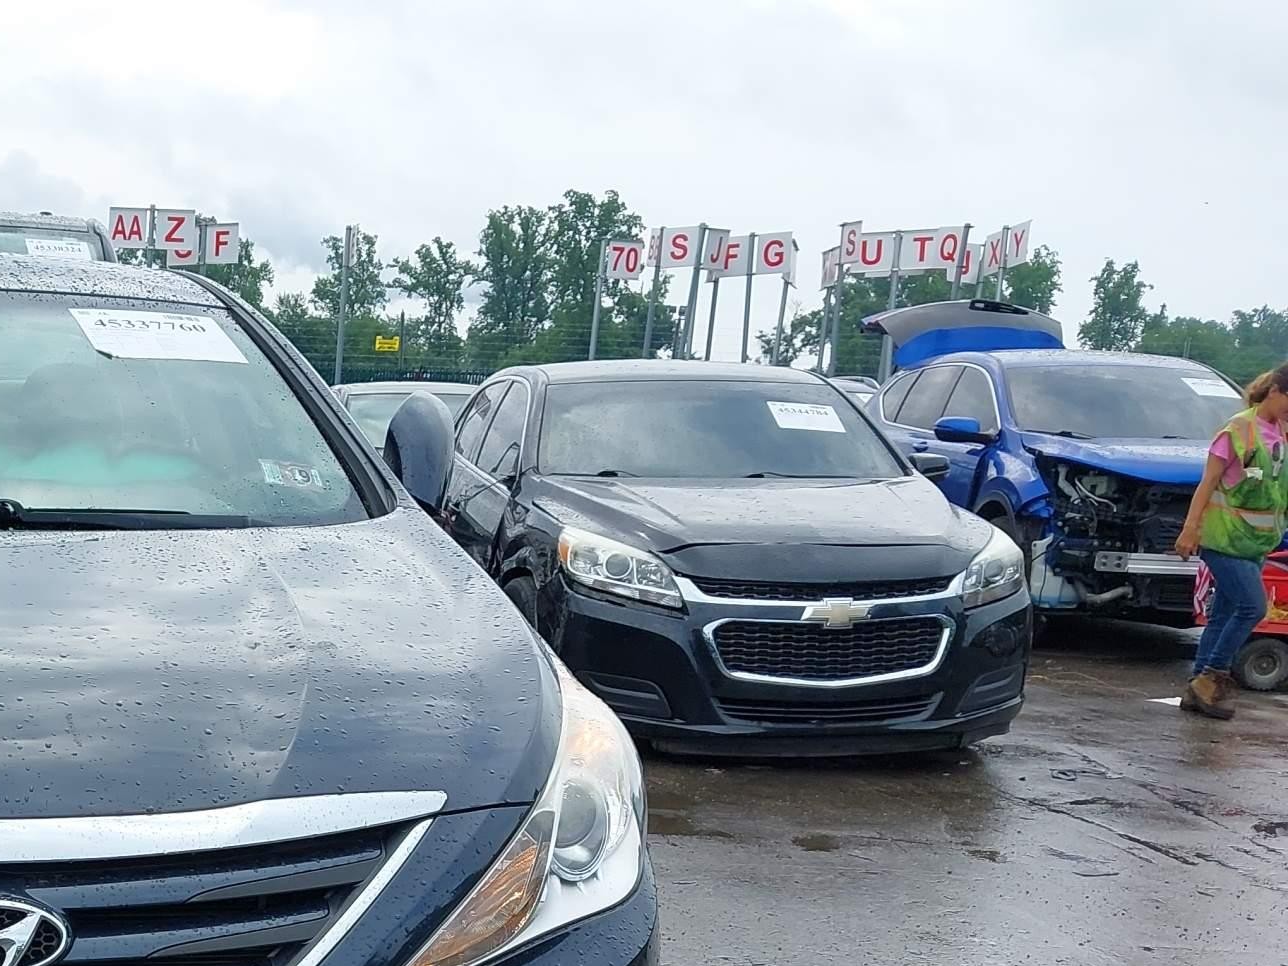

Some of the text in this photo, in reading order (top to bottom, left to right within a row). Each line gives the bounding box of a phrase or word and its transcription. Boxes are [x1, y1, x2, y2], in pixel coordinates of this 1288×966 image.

[111, 214, 185, 243] AA Z
[845, 229, 857, 257] S
[215, 230, 230, 257] F
[669, 233, 724, 264] S J
[724, 239, 785, 270] F G
[861, 239, 883, 265] U
[913, 236, 934, 262] T
[940, 234, 956, 263] Q
[988, 230, 1026, 268] X Y
[612, 246, 639, 273] 70
[94, 318, 207, 333] 45337760
